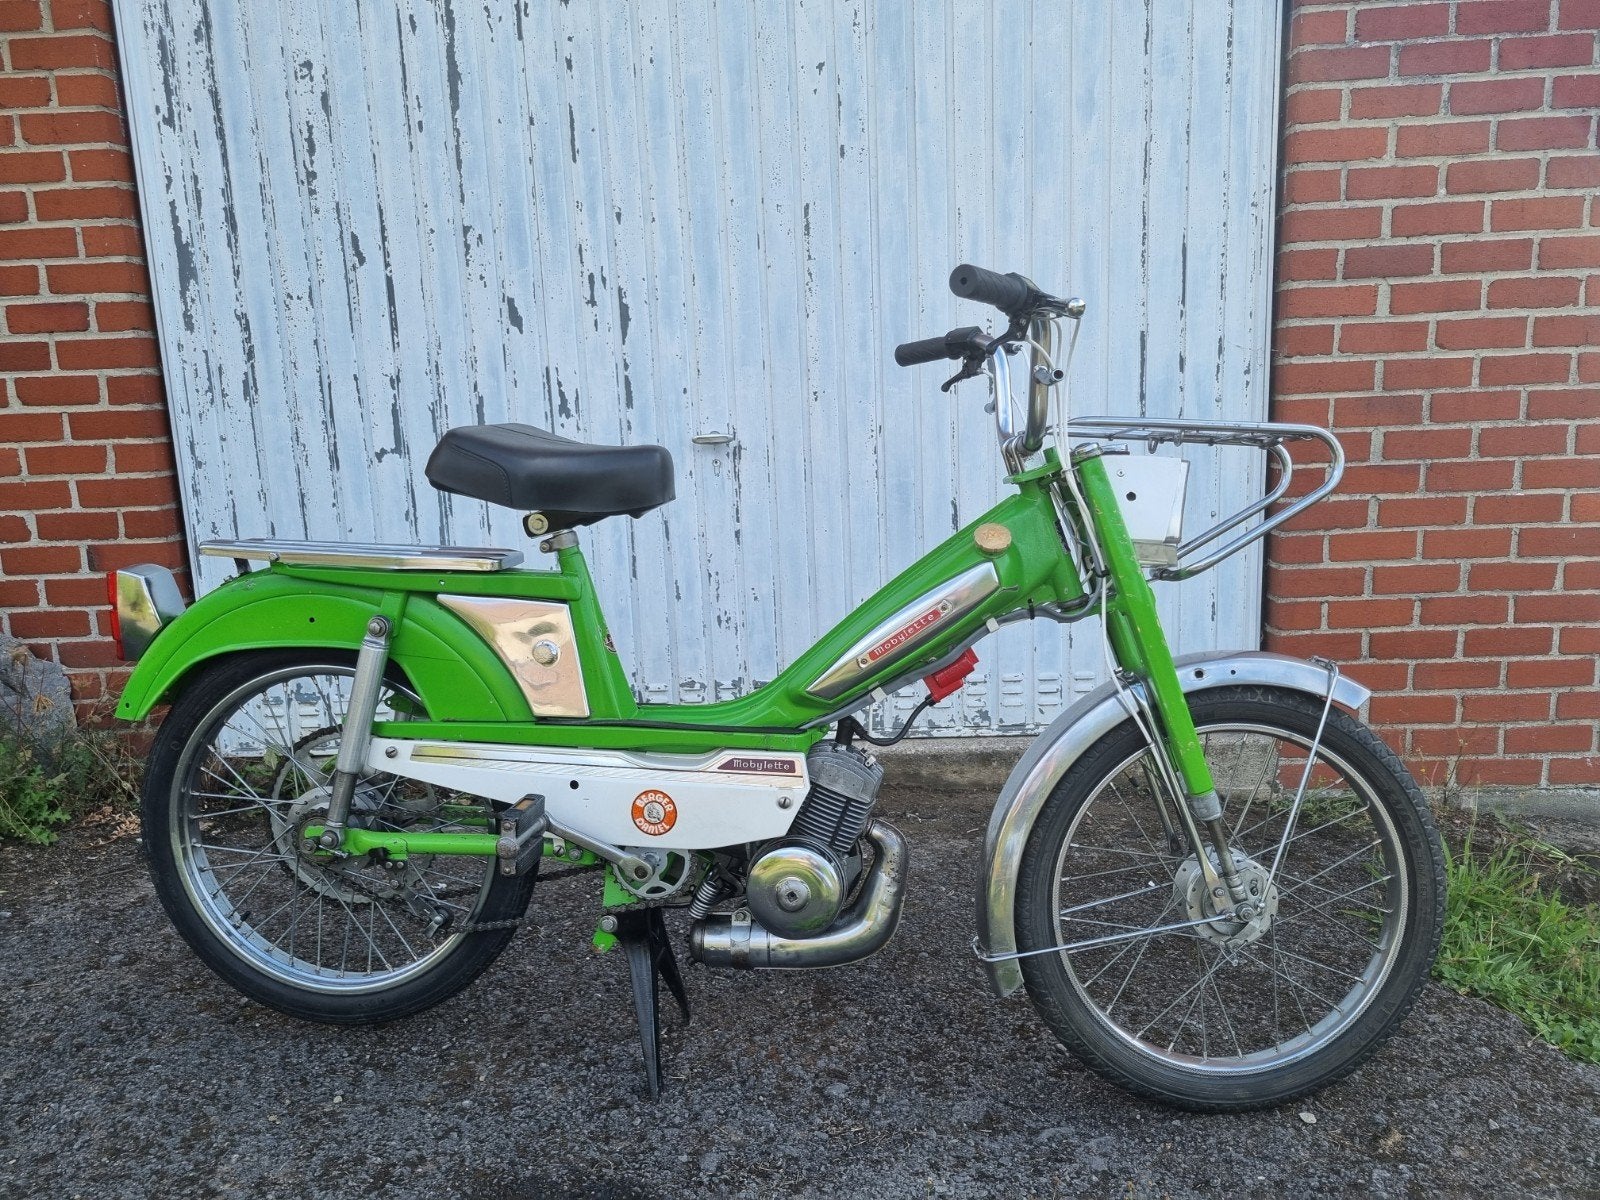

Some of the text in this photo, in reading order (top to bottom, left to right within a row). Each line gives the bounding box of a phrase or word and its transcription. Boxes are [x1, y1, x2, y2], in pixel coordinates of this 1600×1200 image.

[733, 759, 790, 771] Mobylette
[635, 792, 674, 812] BERGER
[634, 817, 671, 834] DANIEL
